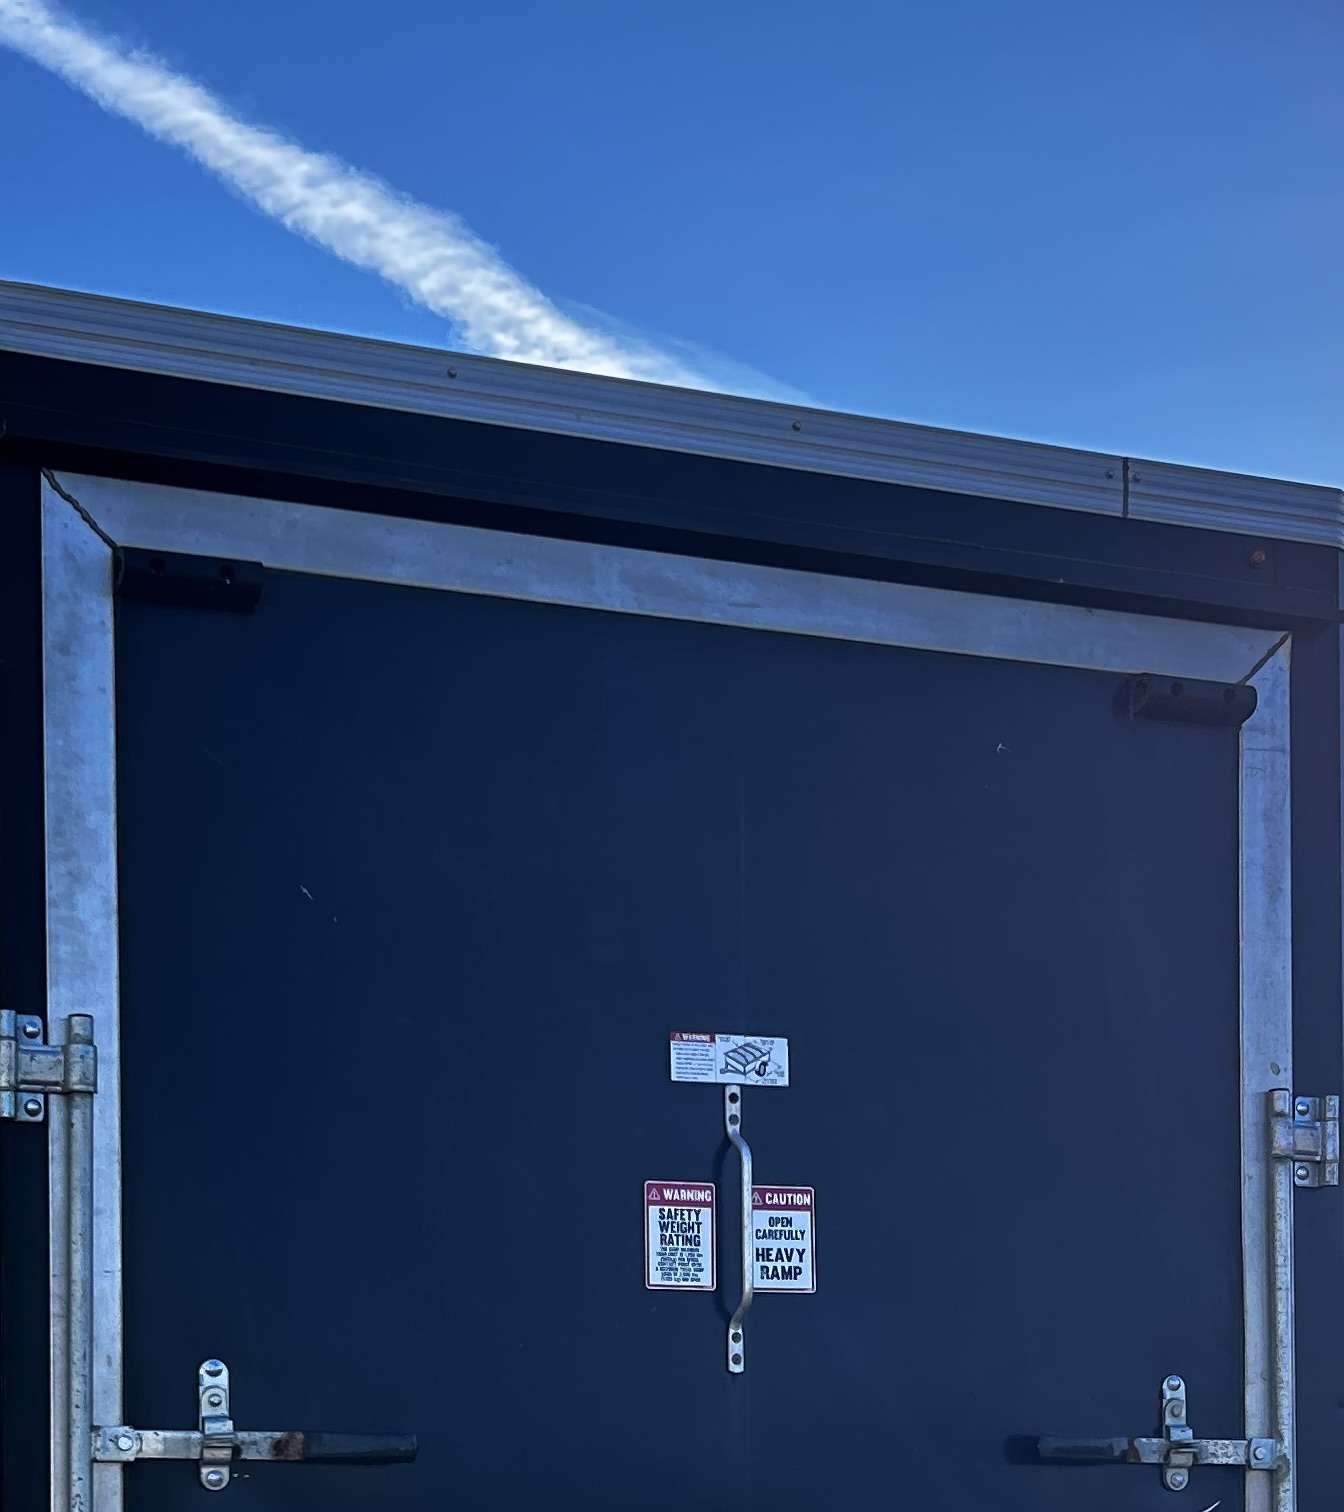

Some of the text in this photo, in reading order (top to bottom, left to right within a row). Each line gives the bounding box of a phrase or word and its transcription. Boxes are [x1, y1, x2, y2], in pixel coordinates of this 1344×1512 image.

[663, 1188, 712, 1202] WARNING
[765, 1192, 811, 1206] CAUTION
[658, 1208, 702, 1221] SAFETY
[658, 1221, 703, 1234] WEIGHT
[768, 1216, 793, 1228] OPEN
[659, 1234, 701, 1247] RATING
[755, 1229, 806, 1241] CAREFULLY
[755, 1247, 806, 1263] HEAVY
[760, 1265, 803, 1281] RAMP
